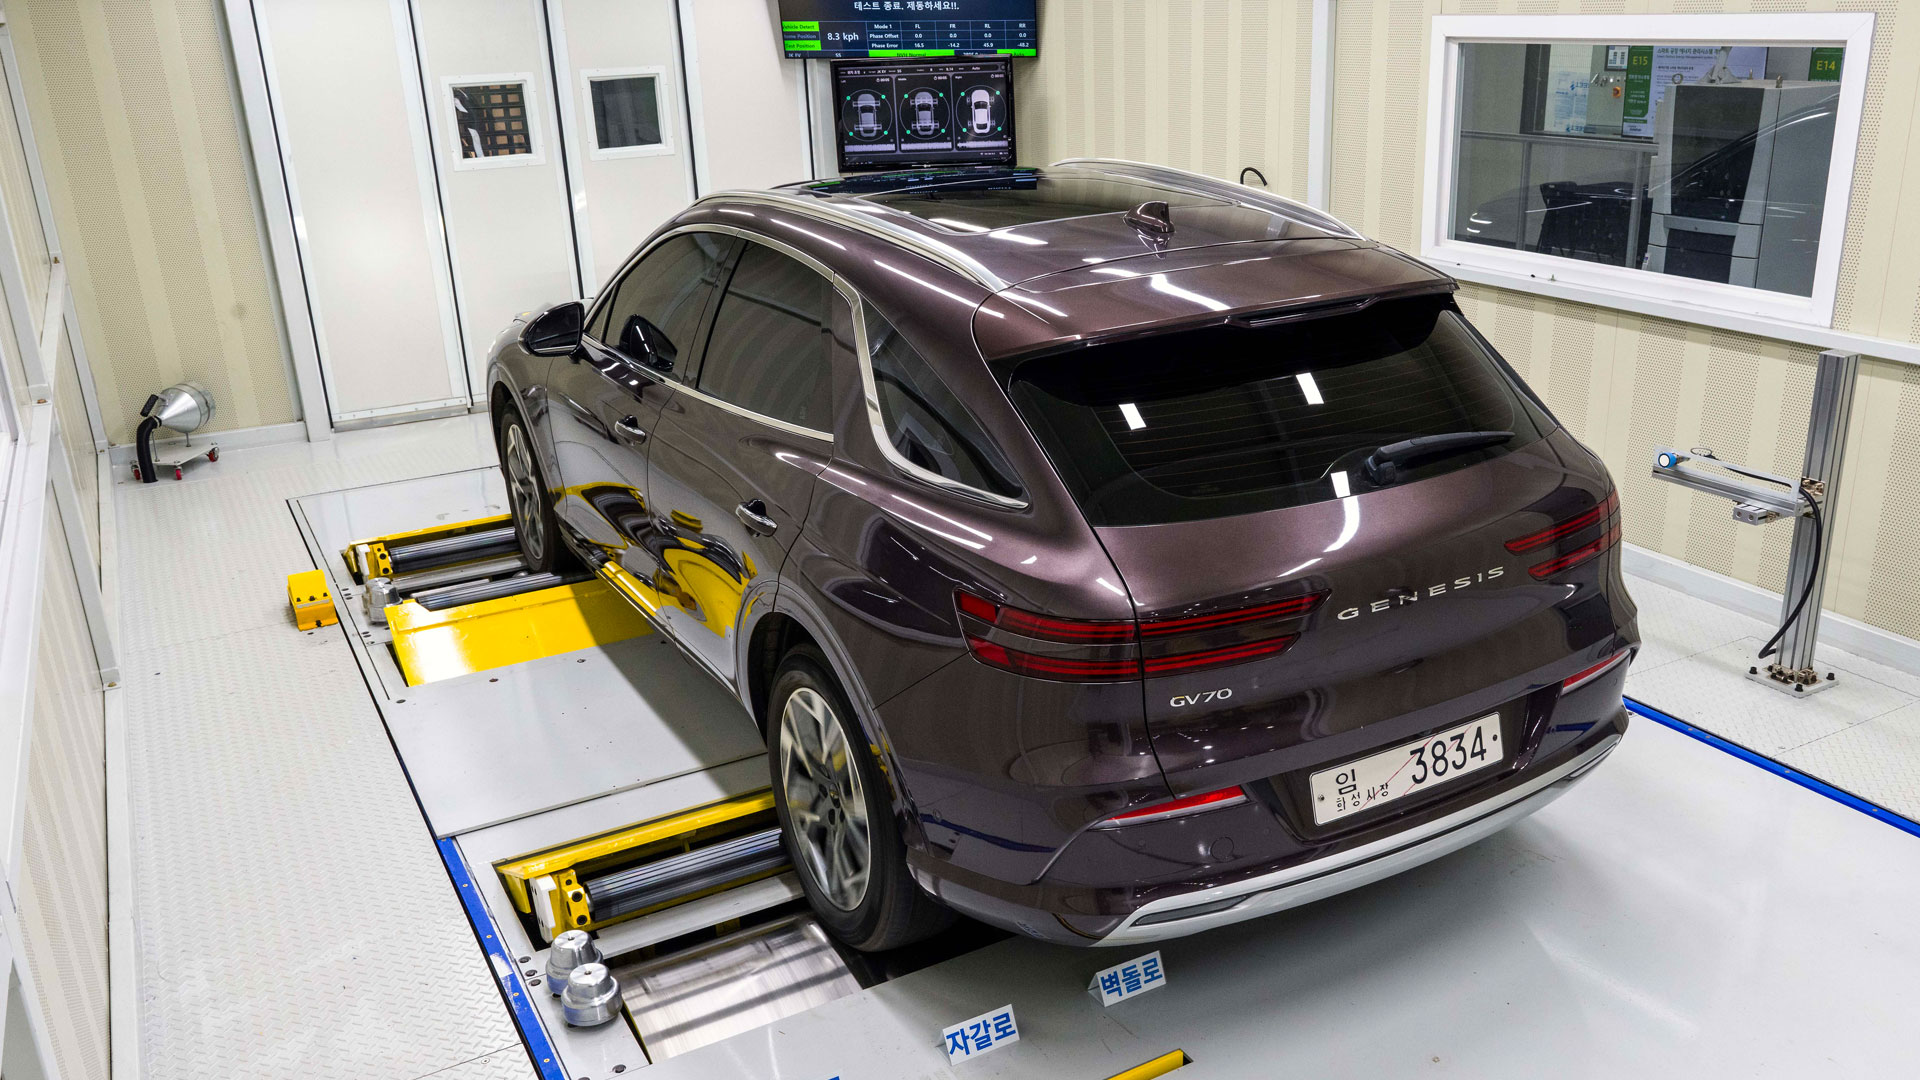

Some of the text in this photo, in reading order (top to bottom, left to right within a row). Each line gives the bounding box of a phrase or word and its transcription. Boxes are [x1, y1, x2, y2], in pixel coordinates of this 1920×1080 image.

[854, 1, 880, 11] 테스트
[883, 1, 904, 11] 종료.
[827, 32, 859, 42] 8.3 kph
[1632, 55, 1648, 66] E15
[1816, 60, 1836, 71] E14
[1337, 566, 1504, 620] GENESIS
[1169, 687, 1233, 707] GV70
[1410, 726, 1487, 784] 3834
[1335, 768, 1357, 795] 임
[1100, 956, 1164, 998] 벽돌로
[945, 1012, 1016, 1056] 자갈로
